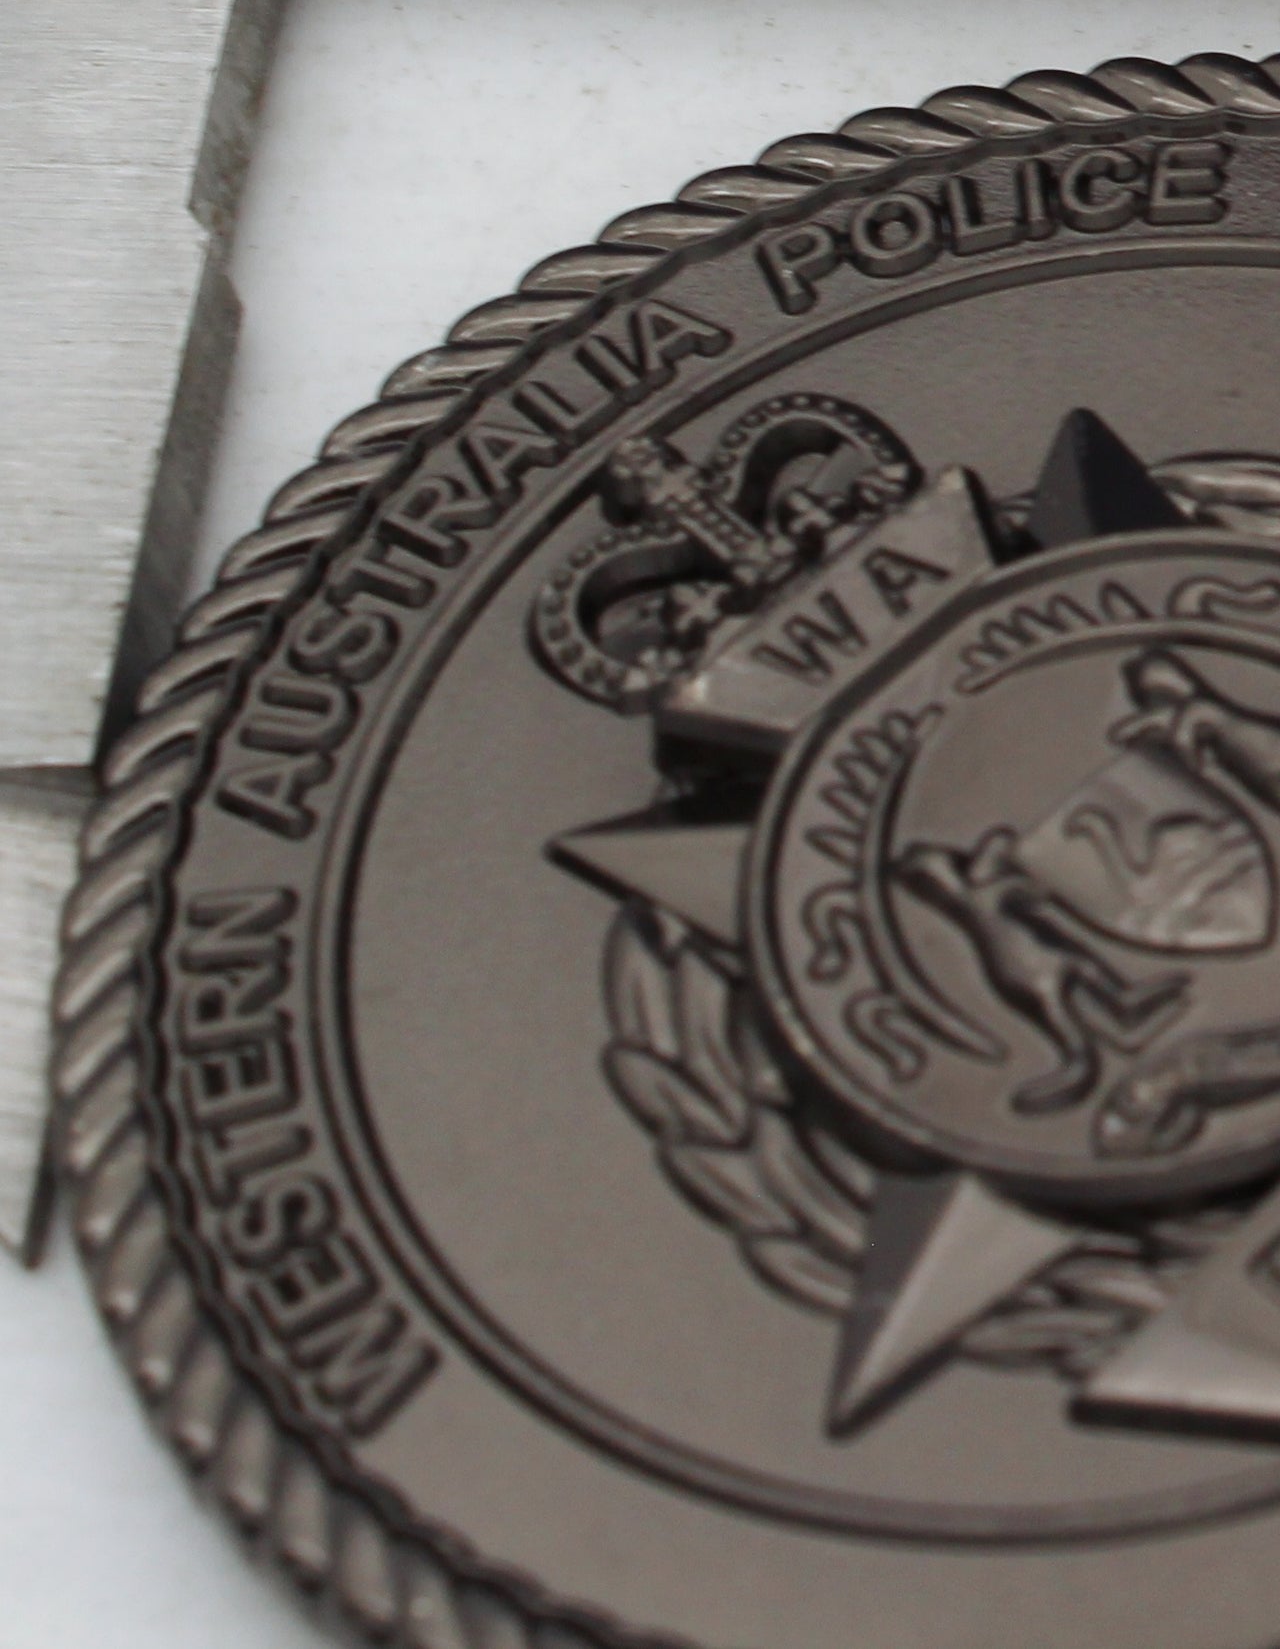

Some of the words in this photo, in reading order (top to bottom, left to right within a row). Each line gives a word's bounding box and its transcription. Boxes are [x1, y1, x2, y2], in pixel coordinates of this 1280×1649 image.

[755, 142, 1232, 316] POLICE
[213, 298, 734, 842] AUSTRALIA
[756, 546, 952, 688] WA
[177, 885, 442, 1440] WESTERN
